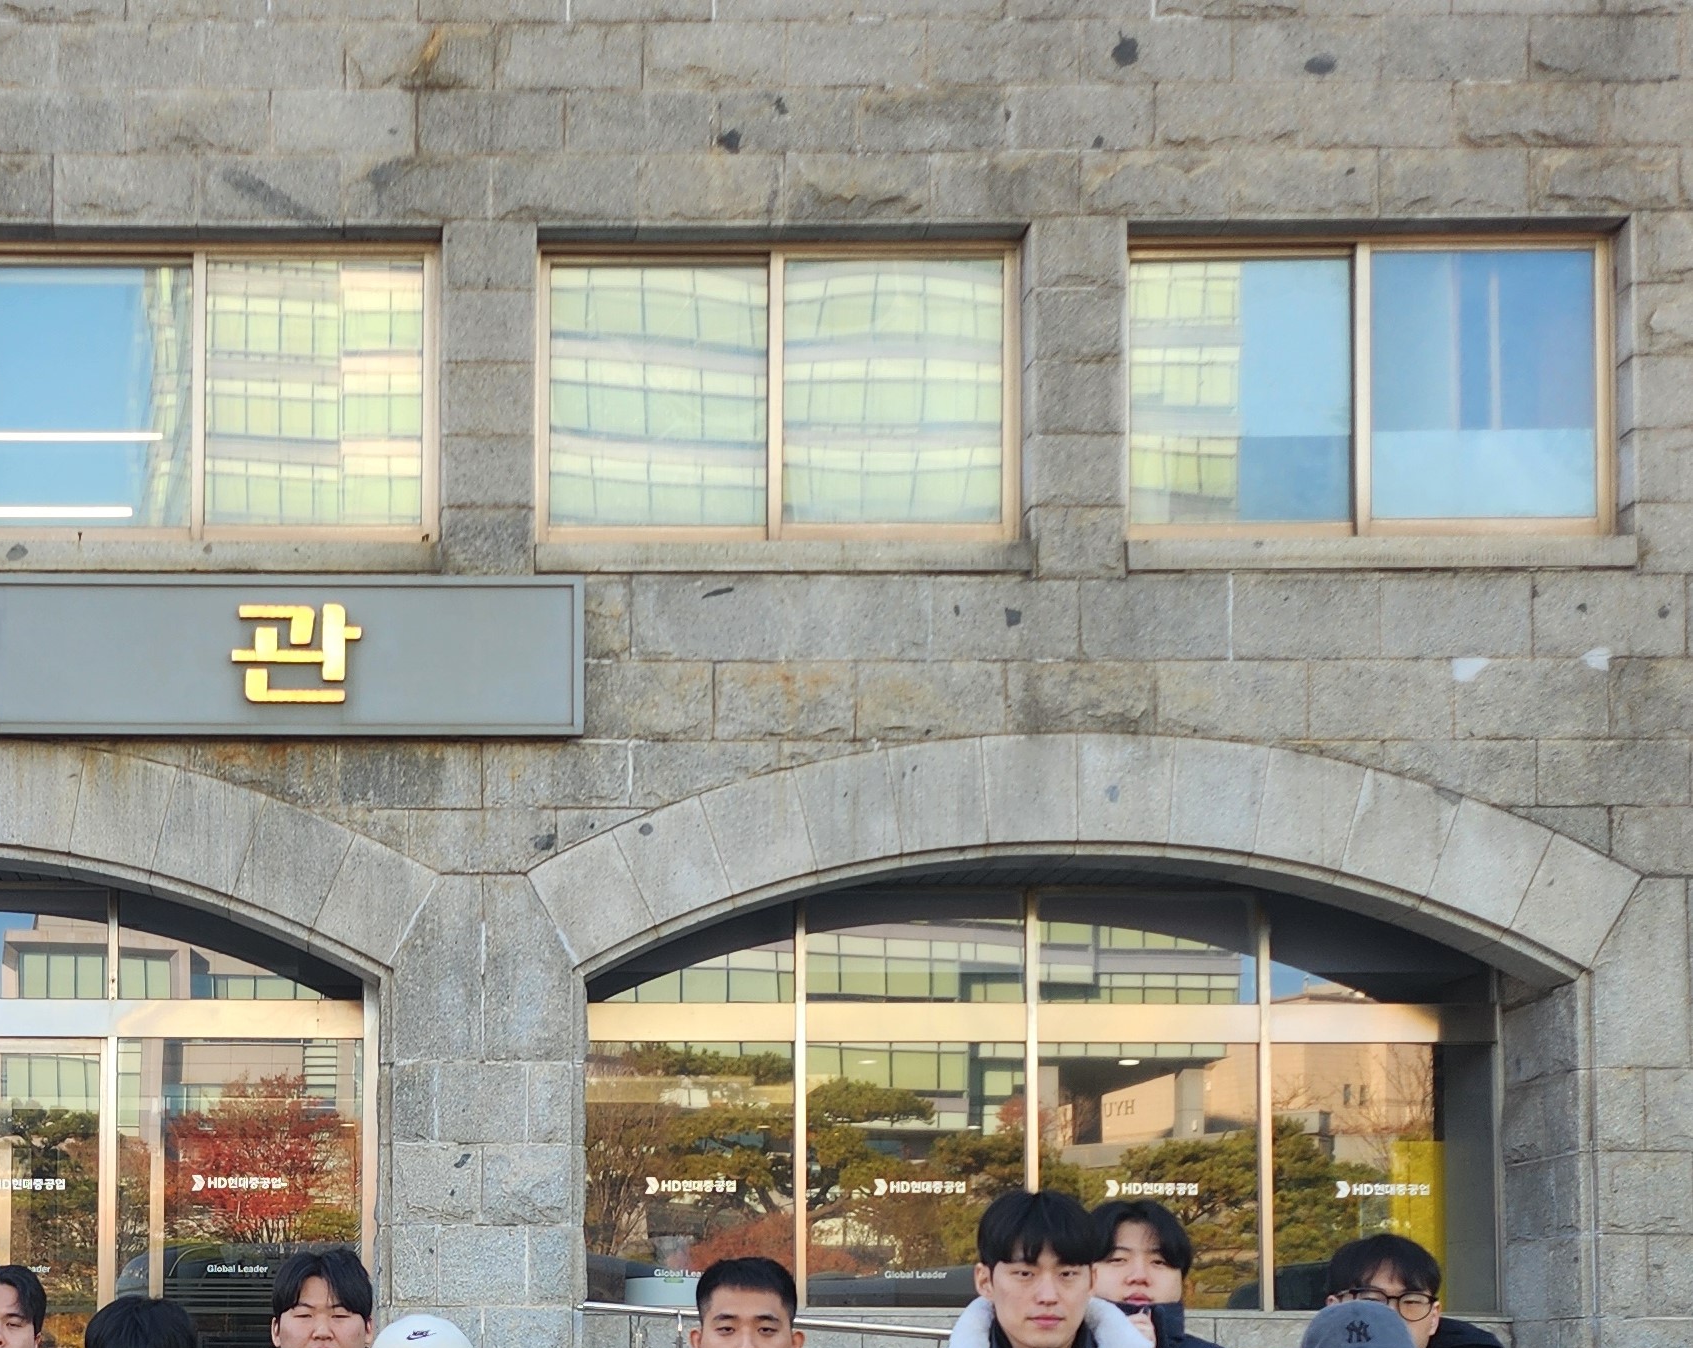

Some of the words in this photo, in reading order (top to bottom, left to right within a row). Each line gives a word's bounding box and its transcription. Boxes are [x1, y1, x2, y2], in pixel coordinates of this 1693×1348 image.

[232, 602, 362, 703] 관
[207, 1176, 282, 1190] HD현대중공업
[661, 1179, 737, 1193] HD현대중공업
[889, 1180, 966, 1194] HD현대중공업
[1121, 1182, 1199, 1196] HD현대중공업
[1351, 1182, 1430, 1196] HD현대중공업
[207, 1264, 236, 1275] Global
[238, 1264, 268, 1274] Leader
[653, 1268, 683, 1279] Global
[884, 1270, 913, 1281] Global
[916, 1270, 947, 1280] Leader
